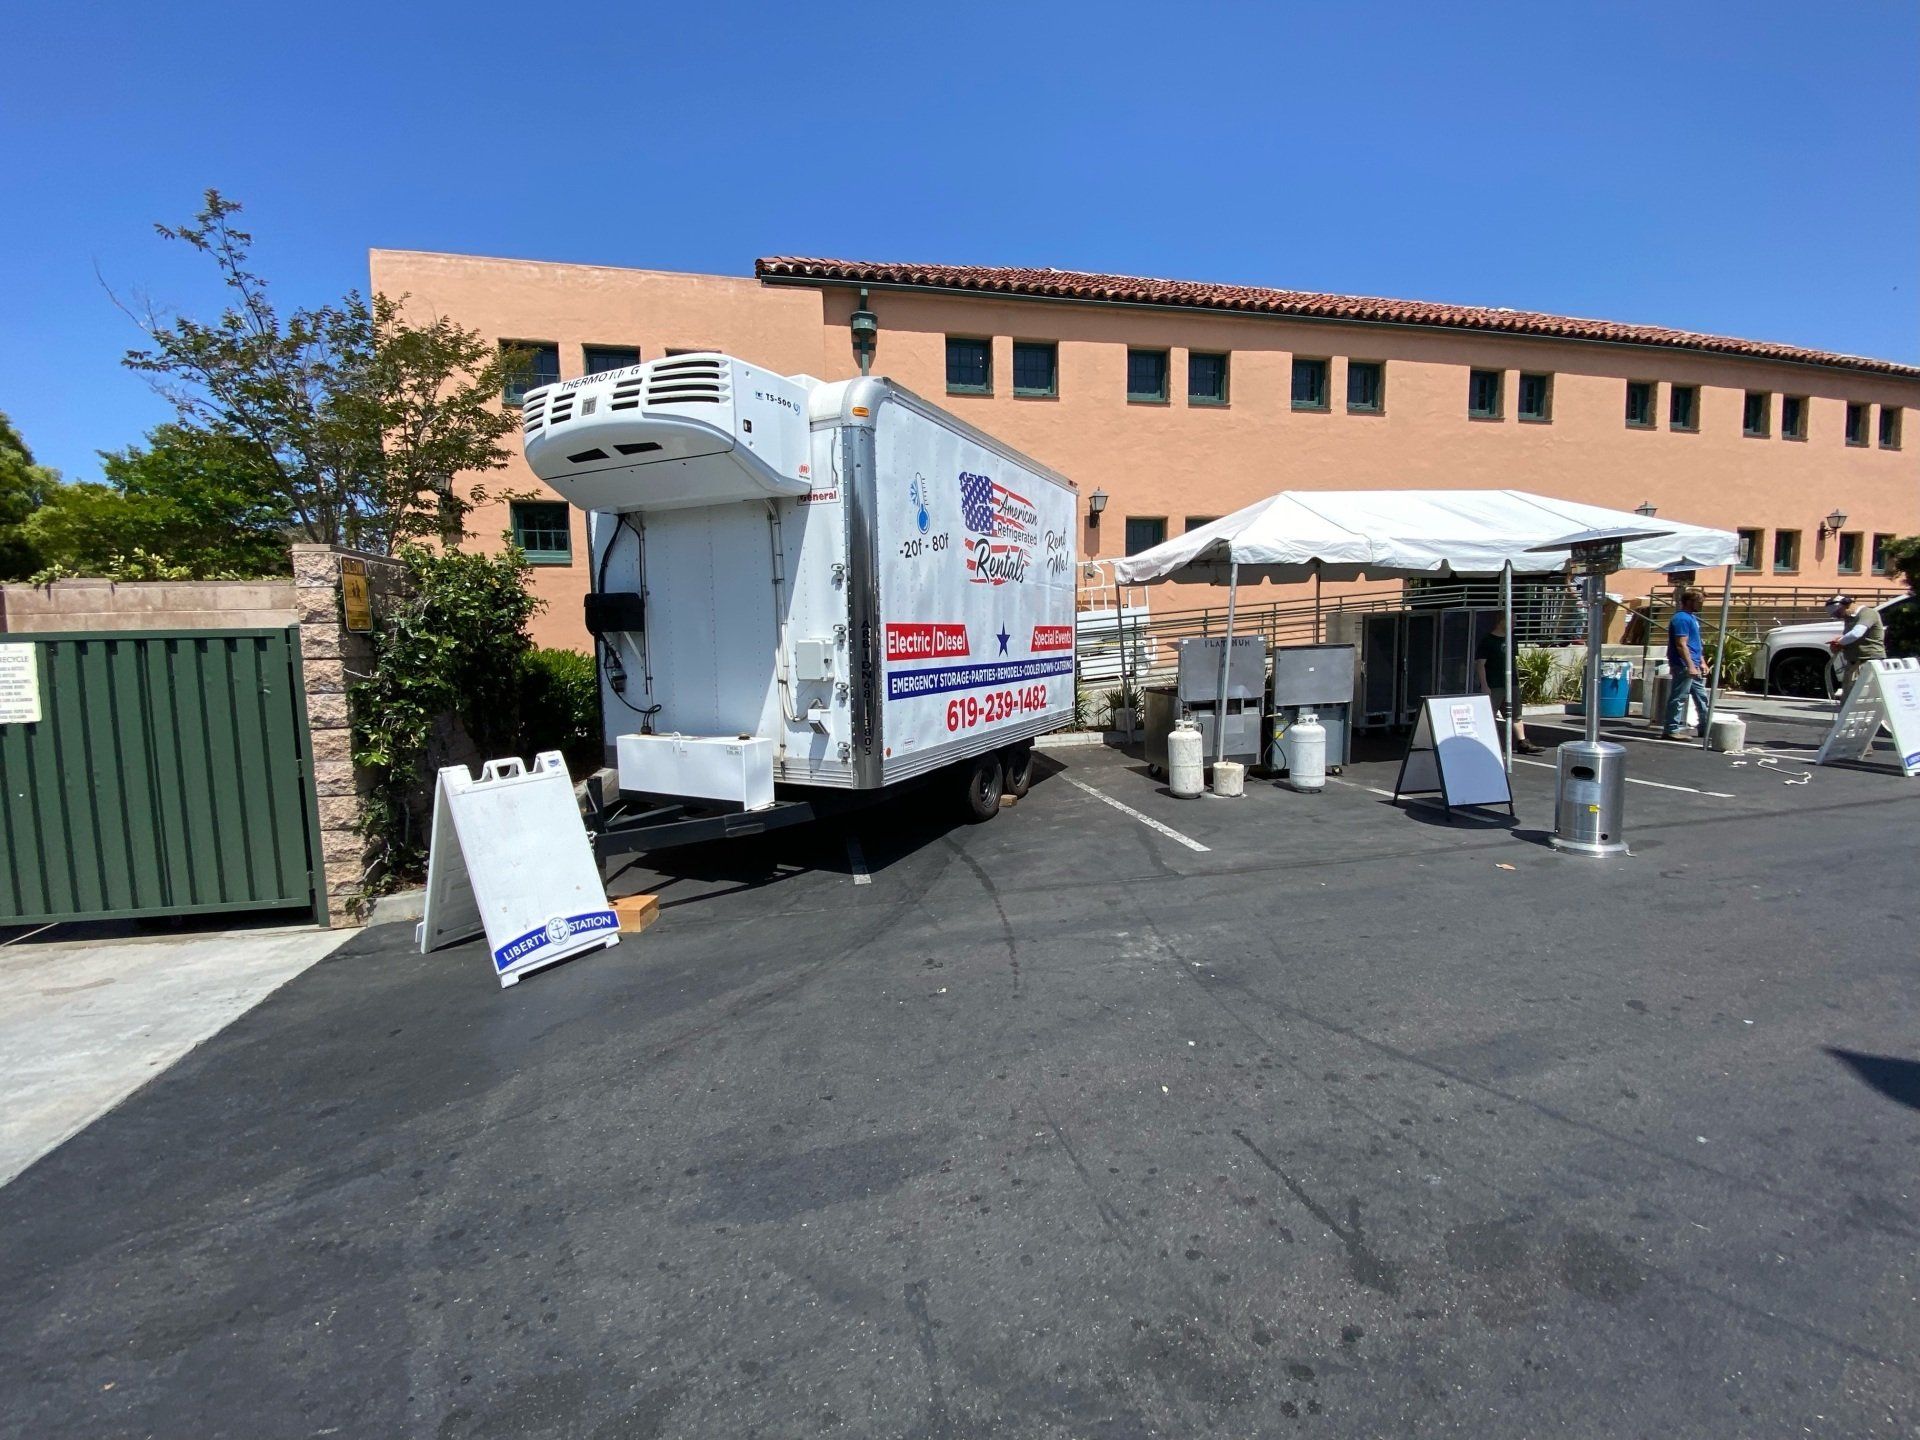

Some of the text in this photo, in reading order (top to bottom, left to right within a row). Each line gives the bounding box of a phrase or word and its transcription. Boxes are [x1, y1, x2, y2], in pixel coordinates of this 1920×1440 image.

[562, 373, 608, 391] THERMO
[765, 393, 792, 408] TS-500
[997, 494, 1038, 526] American
[997, 522, 1038, 545] Refrigerated
[1045, 527, 1067, 555] Rent
[973, 538, 1025, 584] Rentals
[1046, 550, 1069, 578] Me!
[1034, 630, 1072, 648] Special Events
[891, 674, 939, 694] EMERGENCY
[947, 684, 1047, 732] 619-239-1482
[503, 915, 612, 961] LIBERTY STATION
